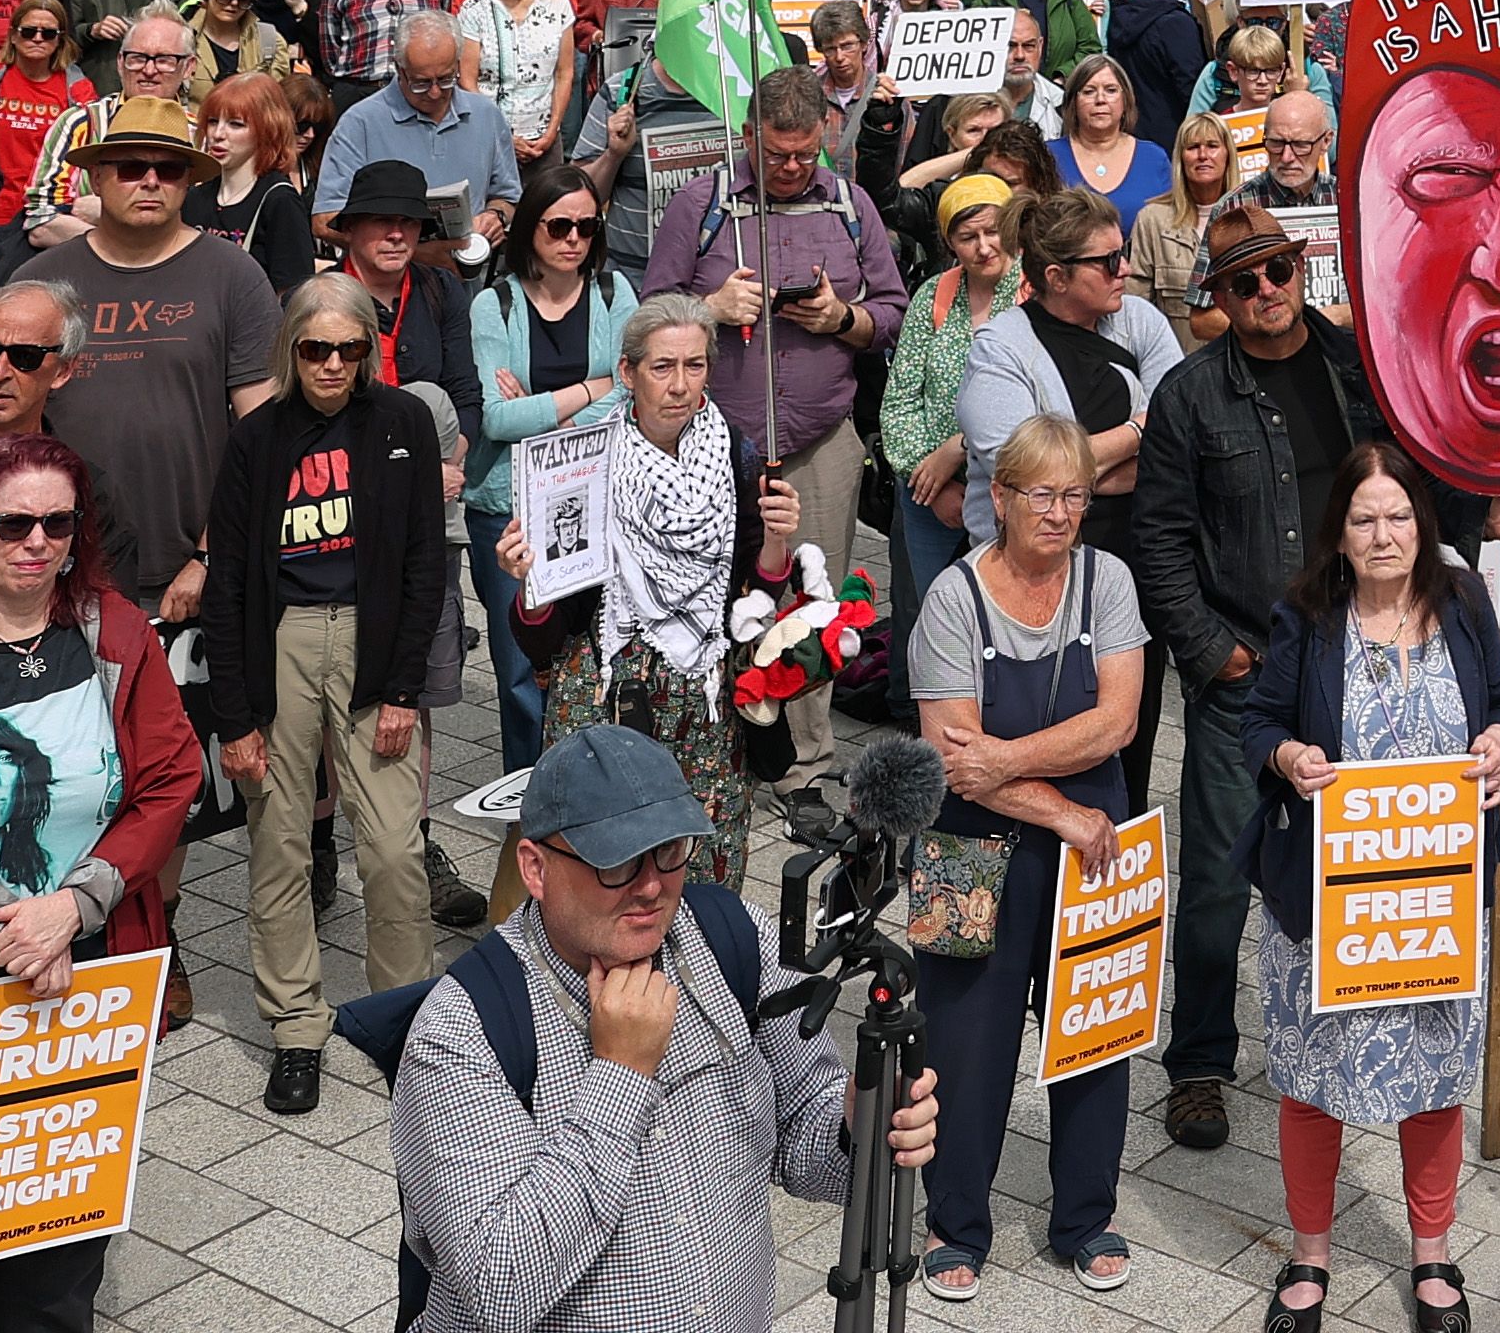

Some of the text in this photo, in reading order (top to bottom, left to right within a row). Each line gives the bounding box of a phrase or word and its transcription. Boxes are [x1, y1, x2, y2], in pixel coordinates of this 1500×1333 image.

[902, 17, 1007, 46] DEPORT
[1374, 27, 1420, 76] IS
[1430, 3, 1463, 45] A
[895, 51, 995, 81] DONALD
[1310, 255, 1337, 277] THE
[529, 428, 608, 472] WANTED
[1342, 783, 1457, 822] STOP
[1324, 823, 1474, 864] TRUMP
[1063, 876, 1163, 938] TRUMP
[1345, 885, 1453, 925] FREE
[1336, 926, 1460, 965] GAZA
[1070, 941, 1148, 996] FREE
[1335, 976, 1460, 996] STOP TRUMP SCOTLAND
[1060, 981, 1147, 1037] GAZA
[46, 1126, 124, 1167] FAR
[37, 1209, 105, 1234] SCOTLAND
